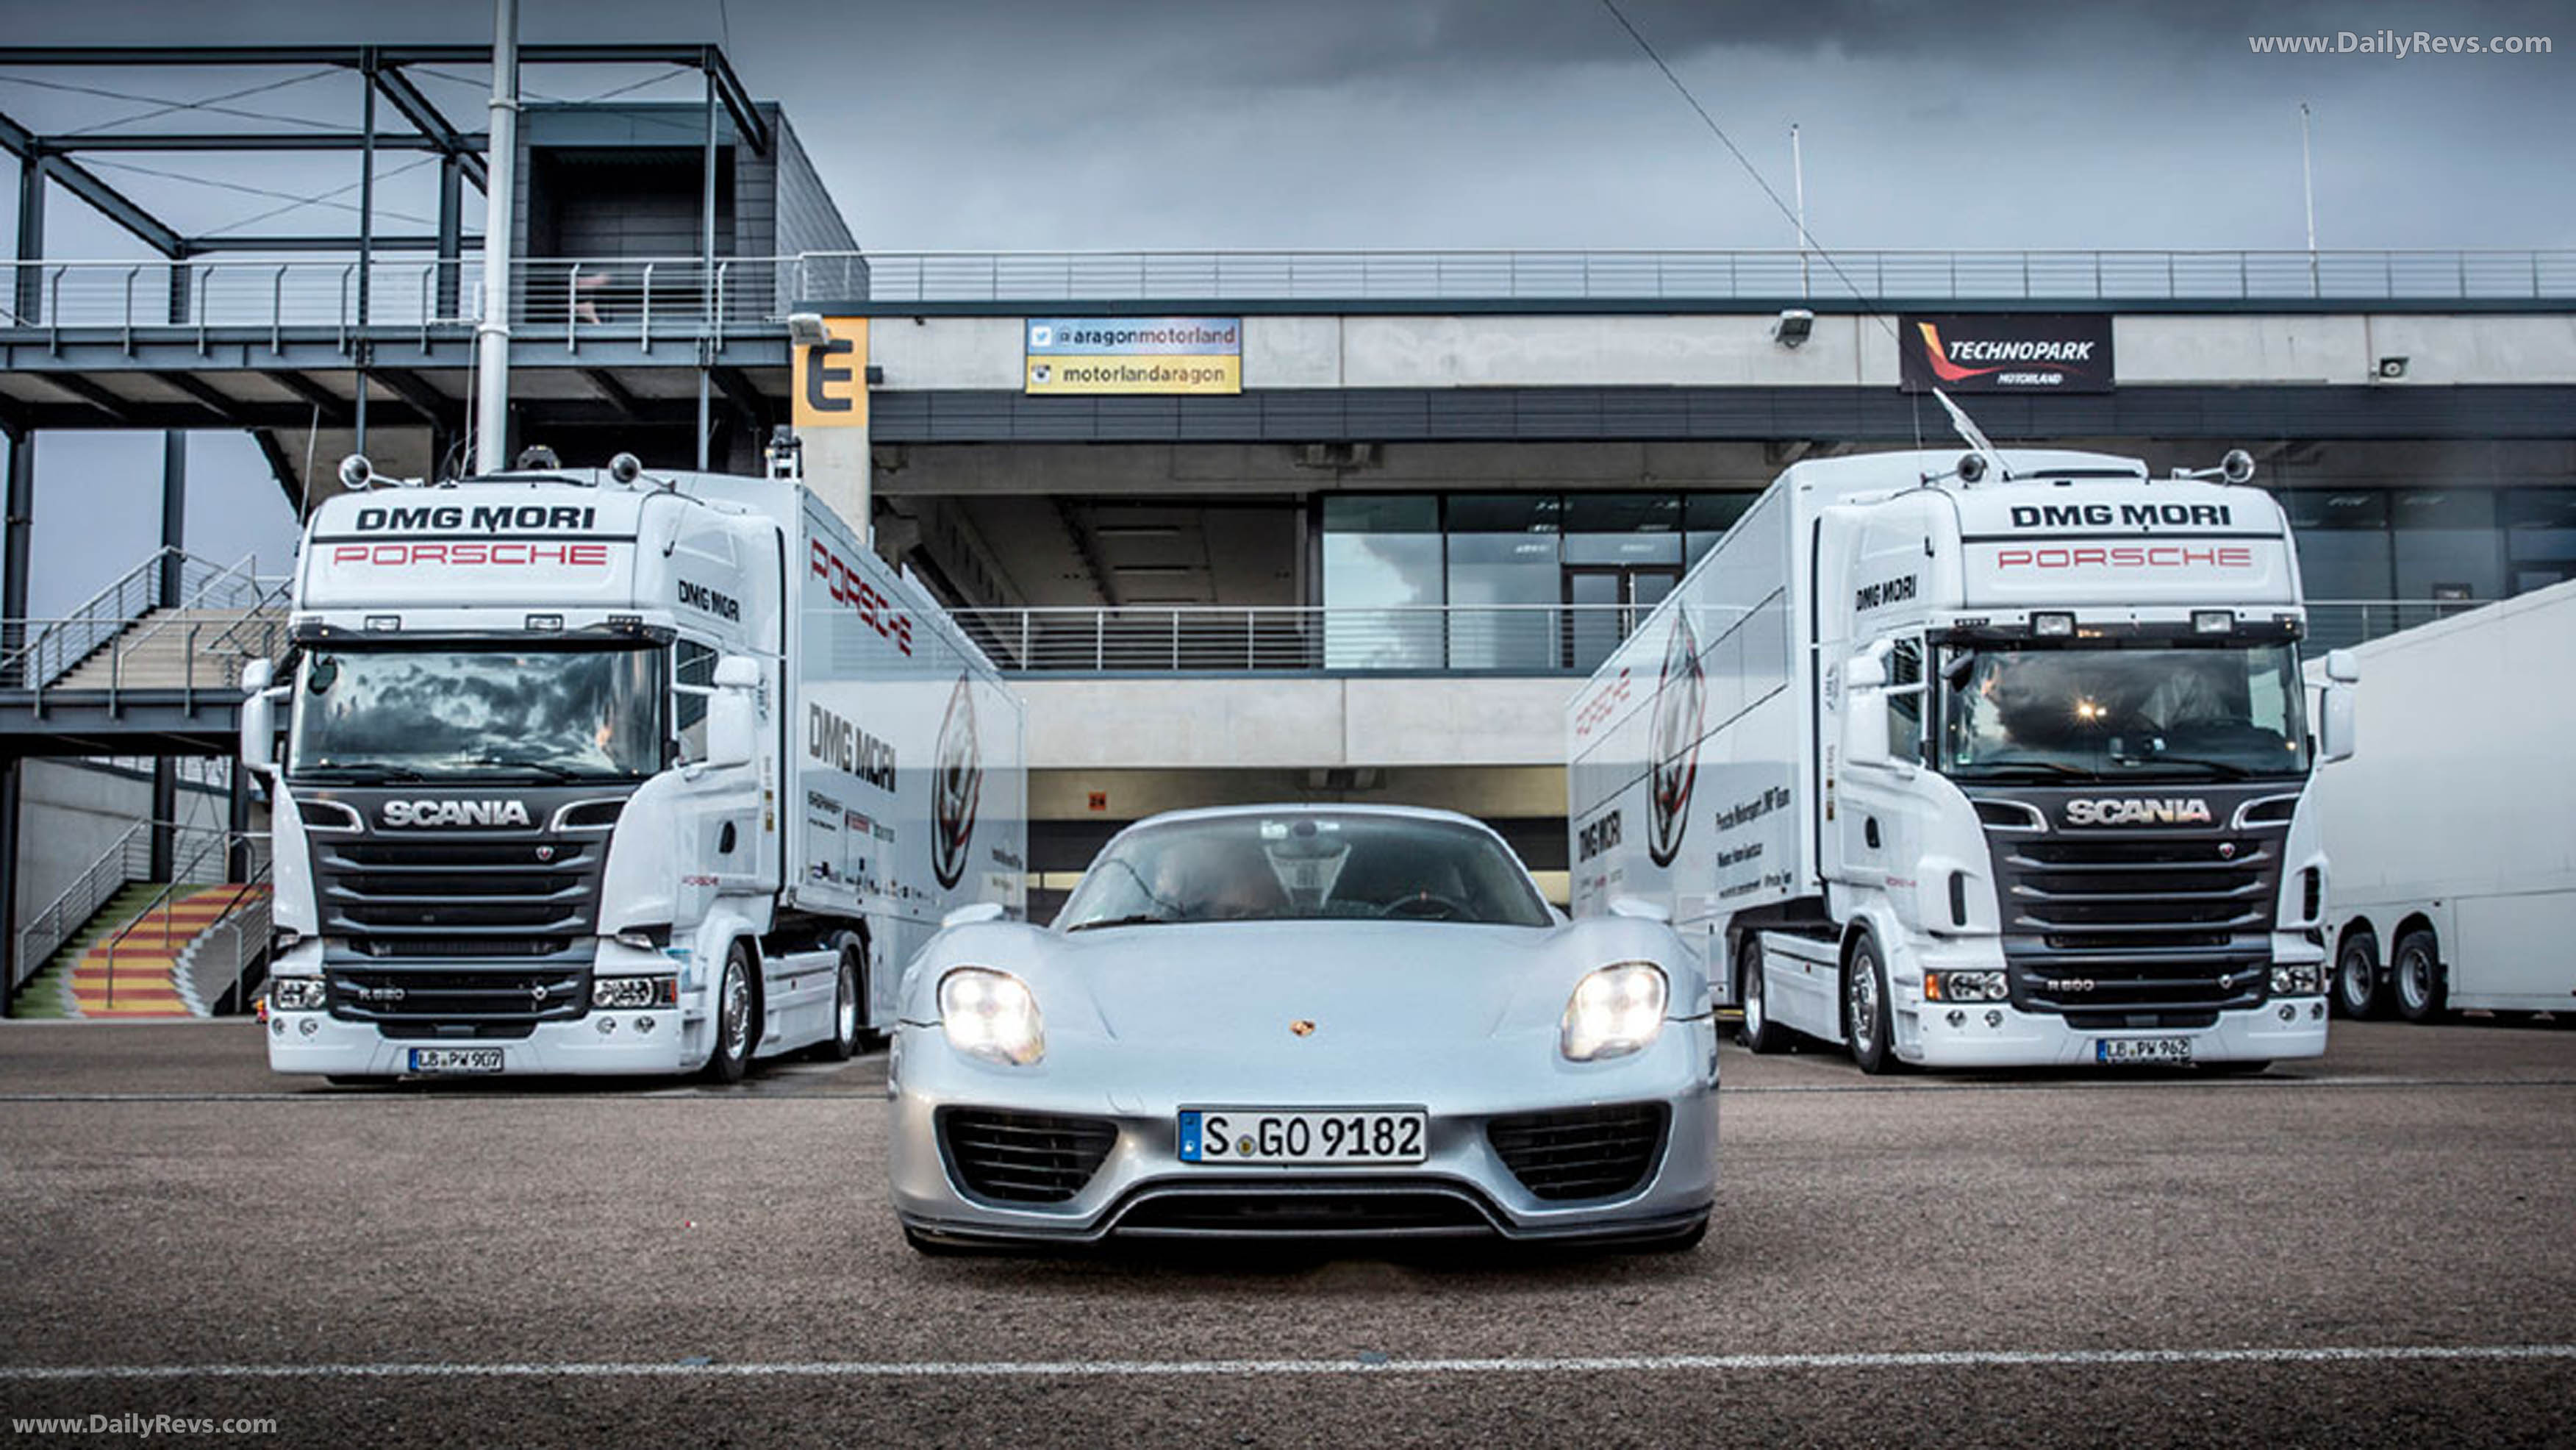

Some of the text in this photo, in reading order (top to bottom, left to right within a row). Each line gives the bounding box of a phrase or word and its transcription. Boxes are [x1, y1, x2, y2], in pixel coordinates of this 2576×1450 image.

[1949, 341, 2095, 360] TECHNOPARK
[807, 339, 853, 411] E
[1064, 365, 1225, 383] motorlandaragon
[1997, 373, 2063, 385] MOTORLAND
[356, 506, 596, 532] DMG MORI
[2011, 504, 2232, 527] DMG MORI
[334, 545, 608, 566] PORSCHE
[1998, 548, 2252, 569] PORSCHE
[678, 578, 710, 612] DMG
[810, 538, 912, 657] PORSCHE
[1856, 574, 1917, 612] DMG MORI
[809, 701, 854, 773] DMG
[855, 726, 896, 793] MORI
[382, 799, 530, 826] SCANIA
[2066, 798, 2212, 824] SCANIA
[472, 1050, 501, 1067] 907
[2106, 1039, 2189, 1057] LB PW 962
[1205, 1116, 1421, 1157] S GO 9182
